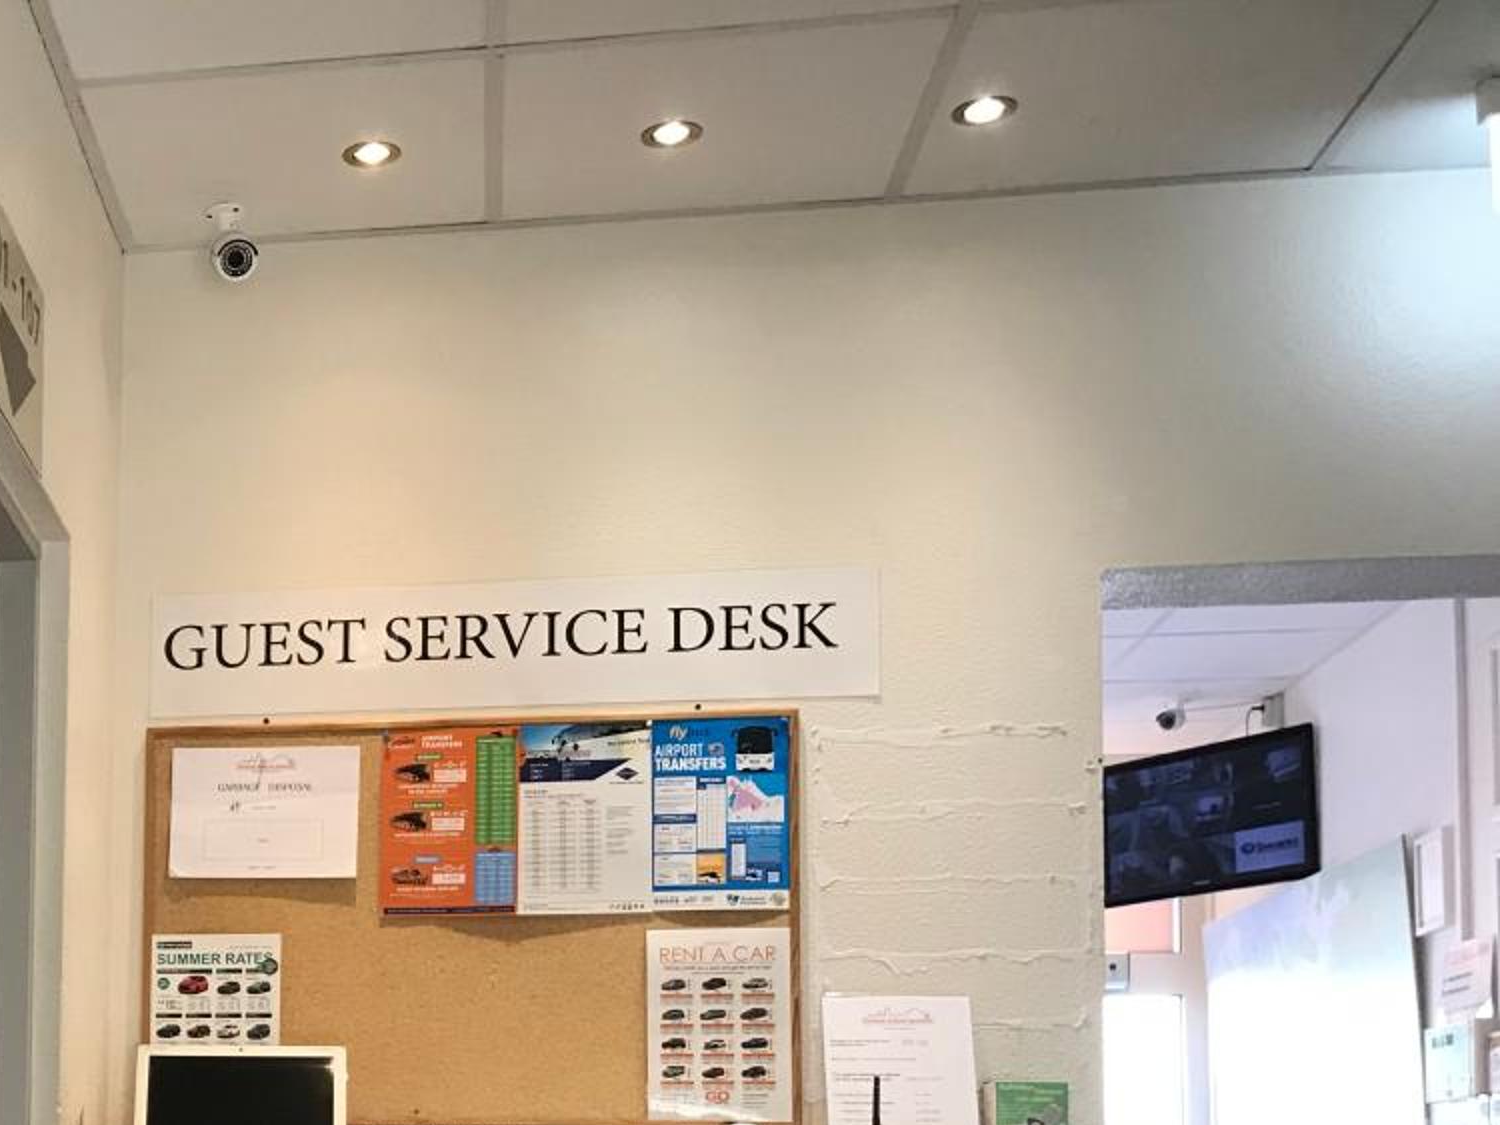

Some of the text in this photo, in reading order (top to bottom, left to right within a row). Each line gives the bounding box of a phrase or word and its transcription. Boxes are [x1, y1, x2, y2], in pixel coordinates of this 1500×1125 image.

[164, 601, 839, 671] GUEST SERVICE DESK
[655, 743, 703, 757] AIRPORT
[655, 757, 727, 772] TRANSFERS
[157, 951, 274, 965] SUMMER RATES
[659, 945, 776, 962] RENT A CAR
